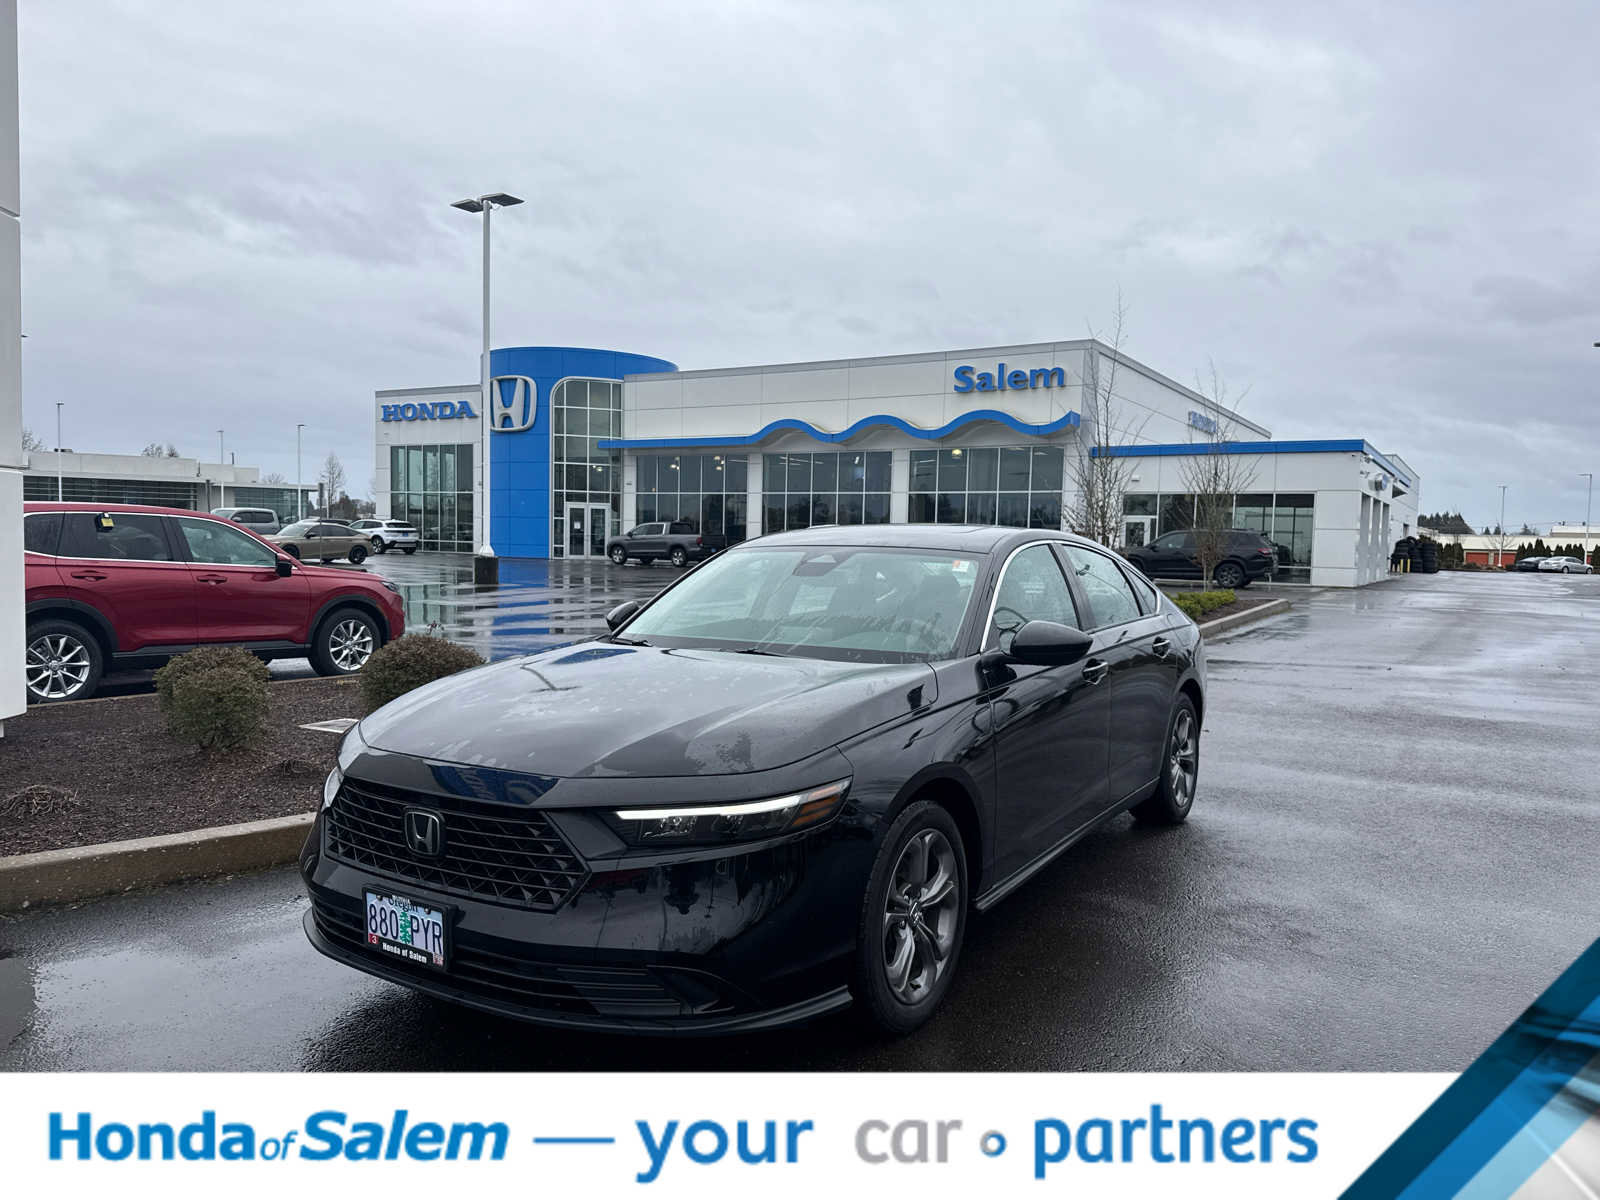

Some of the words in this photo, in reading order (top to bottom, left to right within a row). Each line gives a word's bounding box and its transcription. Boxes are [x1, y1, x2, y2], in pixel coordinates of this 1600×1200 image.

[953, 362, 1065, 392] Salem
[381, 400, 477, 422] HONDA
[369, 904, 399, 939] 880
[410, 915, 442, 954] PYR
[382, 942, 401, 955] Honda
[401, 949, 408, 958] of
[409, 950, 427, 964] Salem
